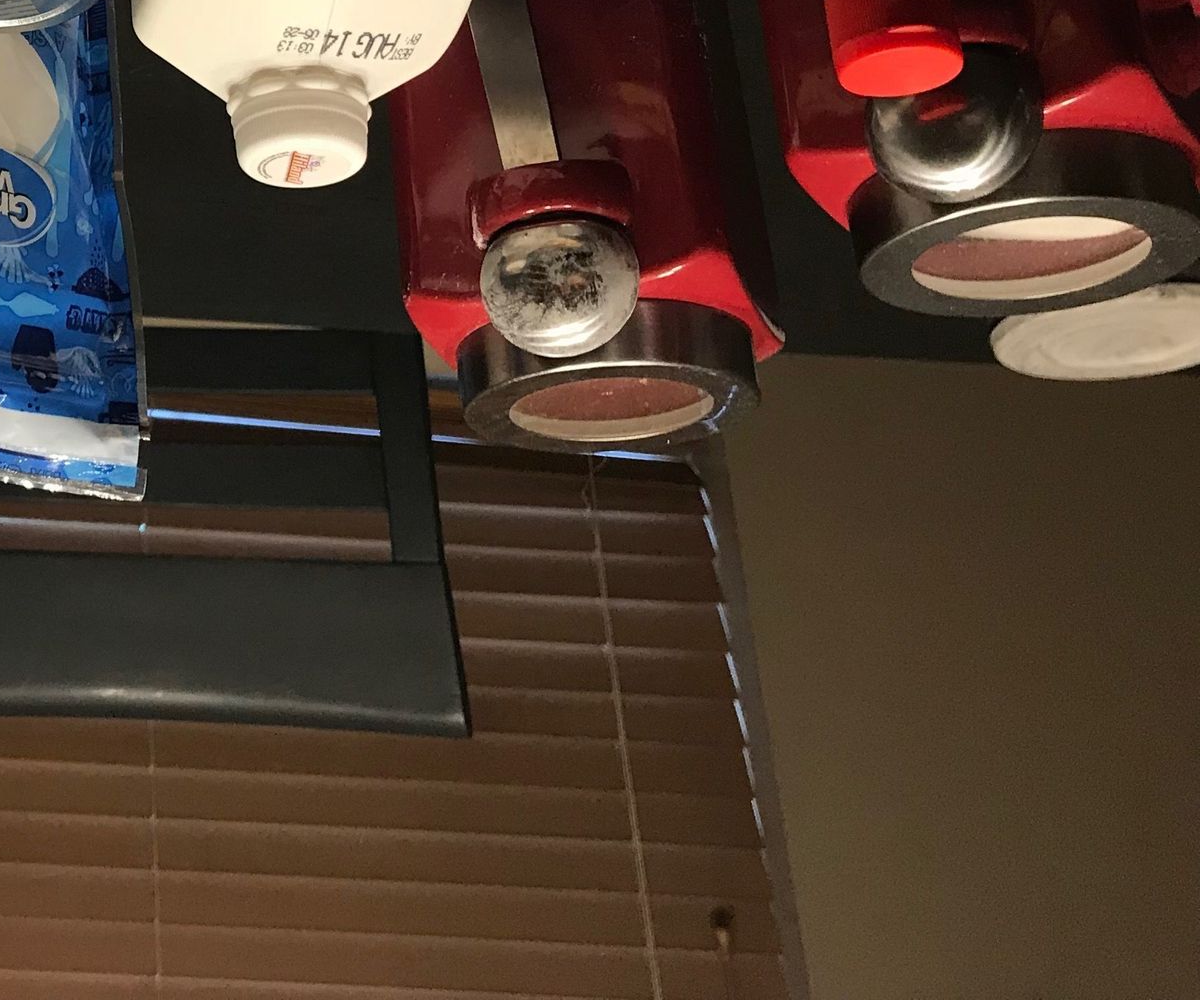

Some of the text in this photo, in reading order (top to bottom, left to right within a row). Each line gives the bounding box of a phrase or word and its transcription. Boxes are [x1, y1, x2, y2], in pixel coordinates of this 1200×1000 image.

[319, 29, 401, 60] AUG 14
[285, 151, 311, 185] Hiland
